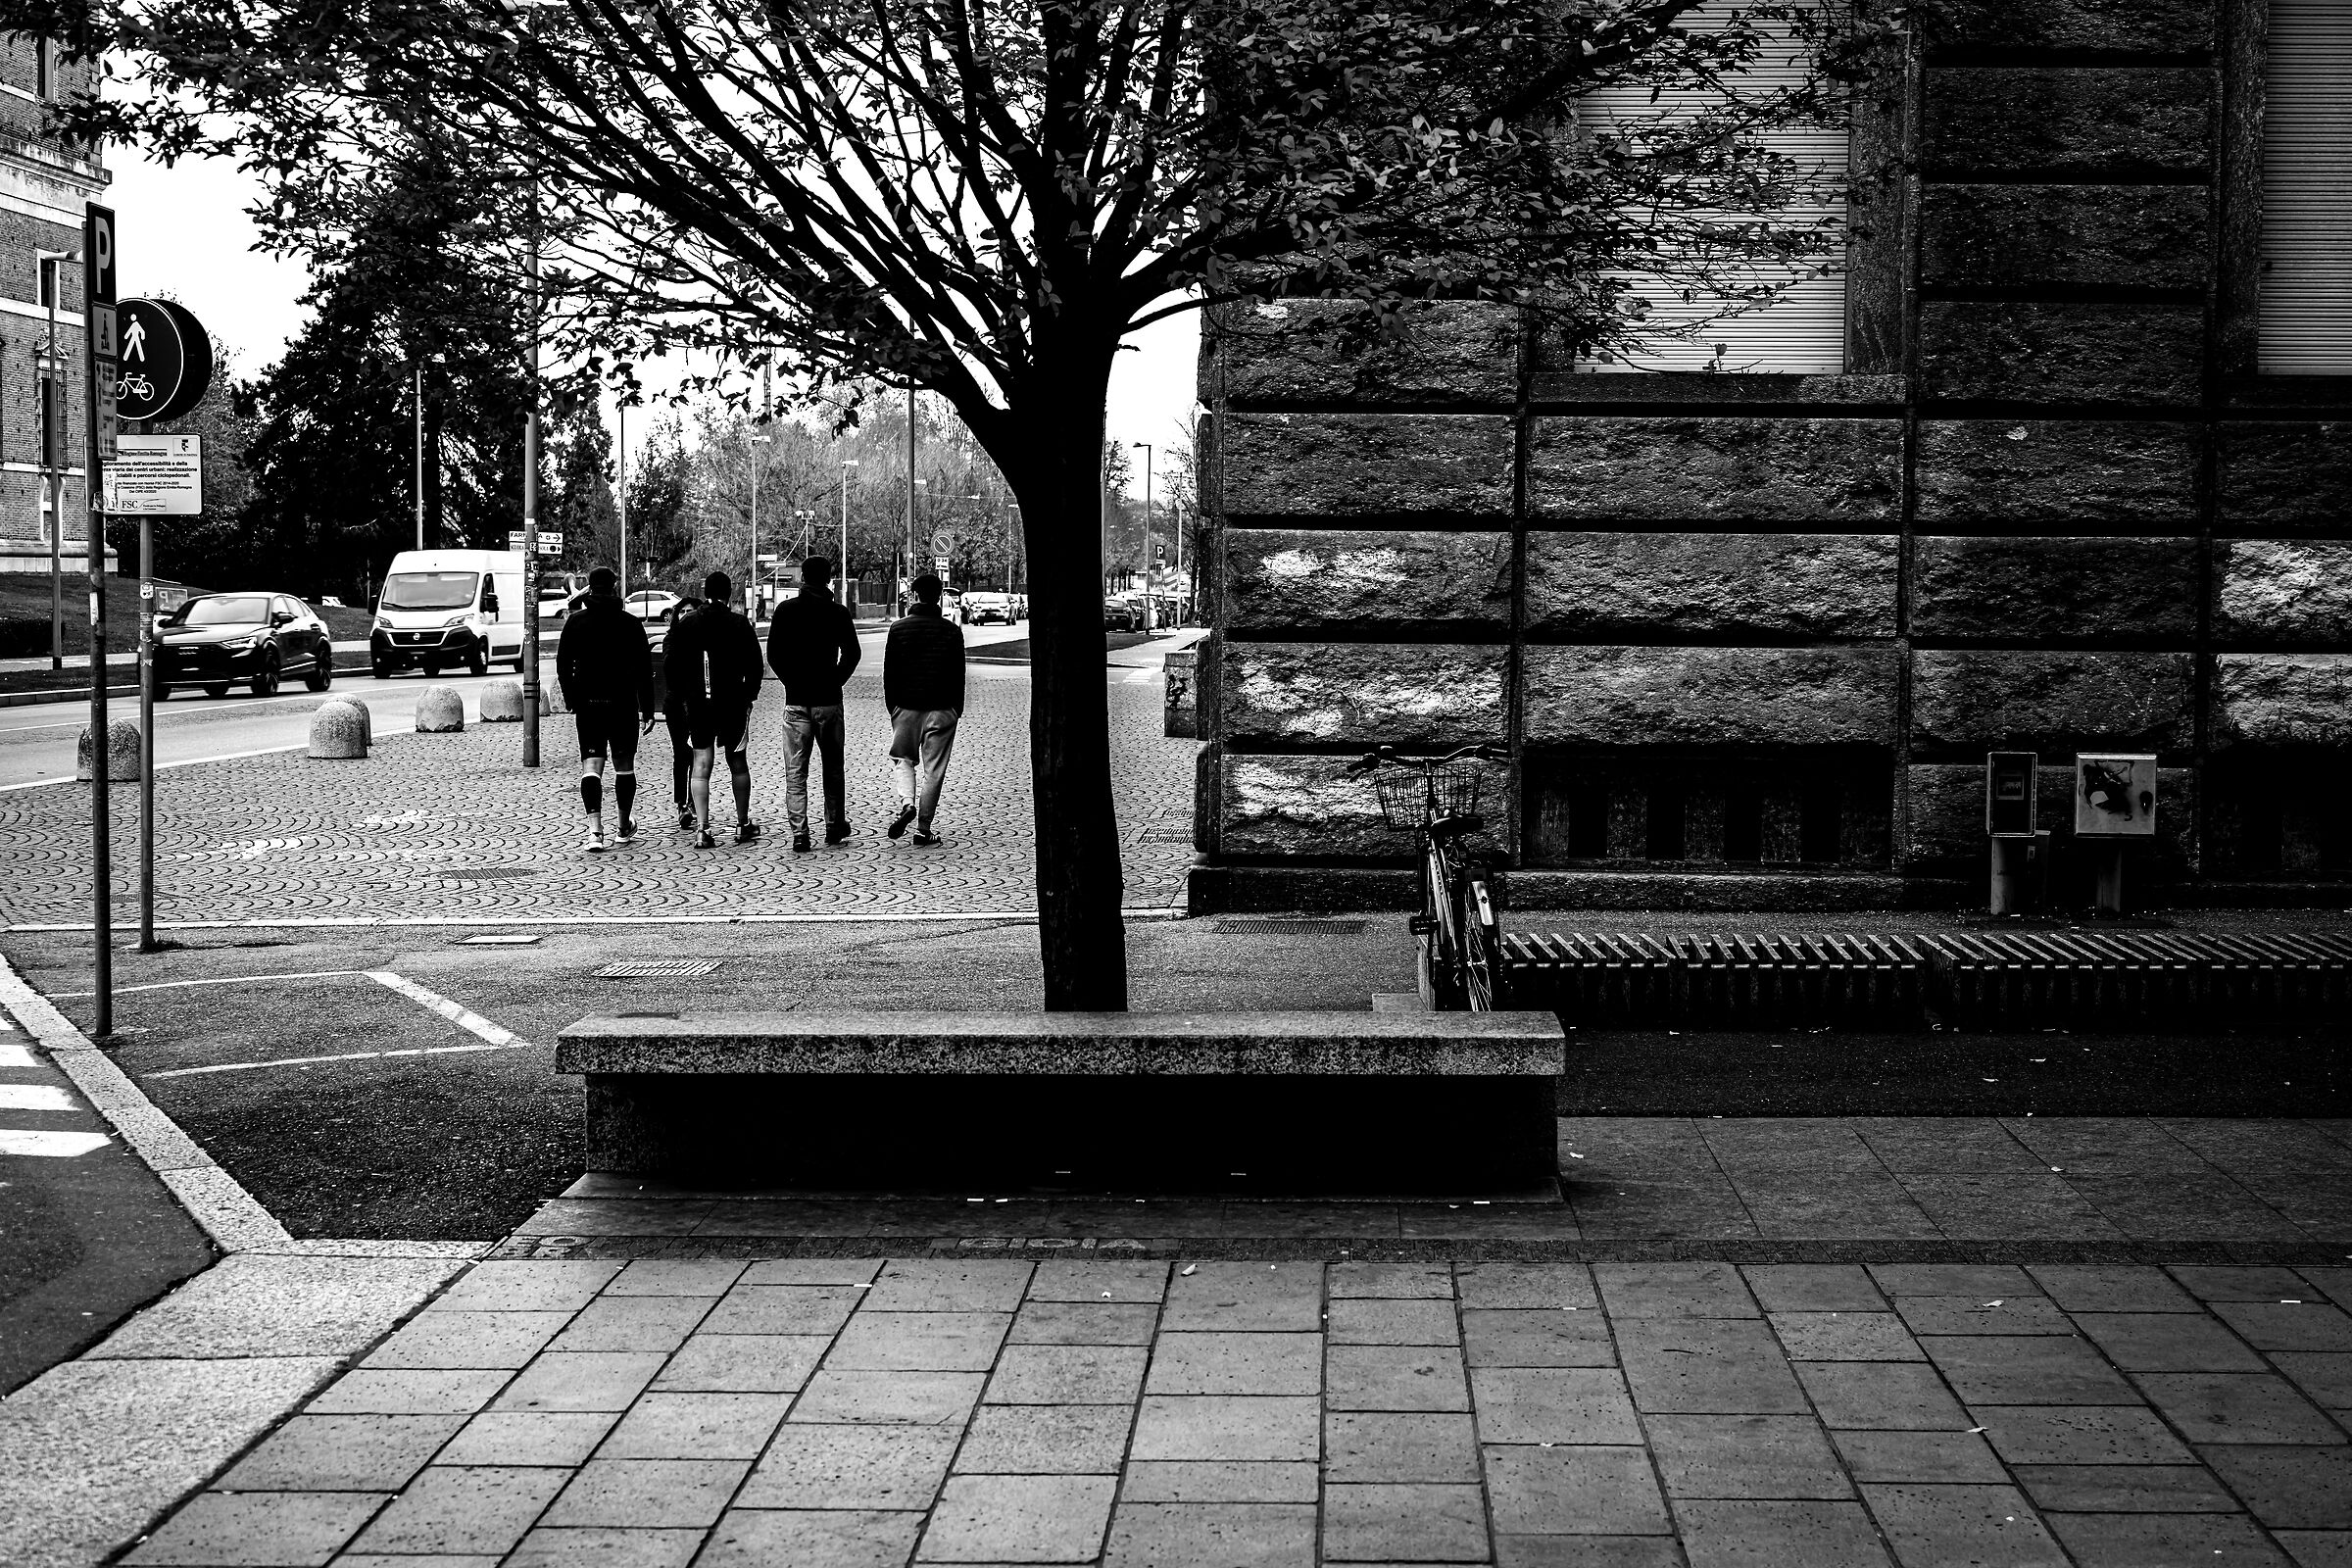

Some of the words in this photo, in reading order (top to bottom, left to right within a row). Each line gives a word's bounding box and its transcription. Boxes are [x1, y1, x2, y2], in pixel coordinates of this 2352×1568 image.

[95, 216, 111, 294] P
[122, 500, 138, 509] FSC
[1156, 545, 1163, 558] P
